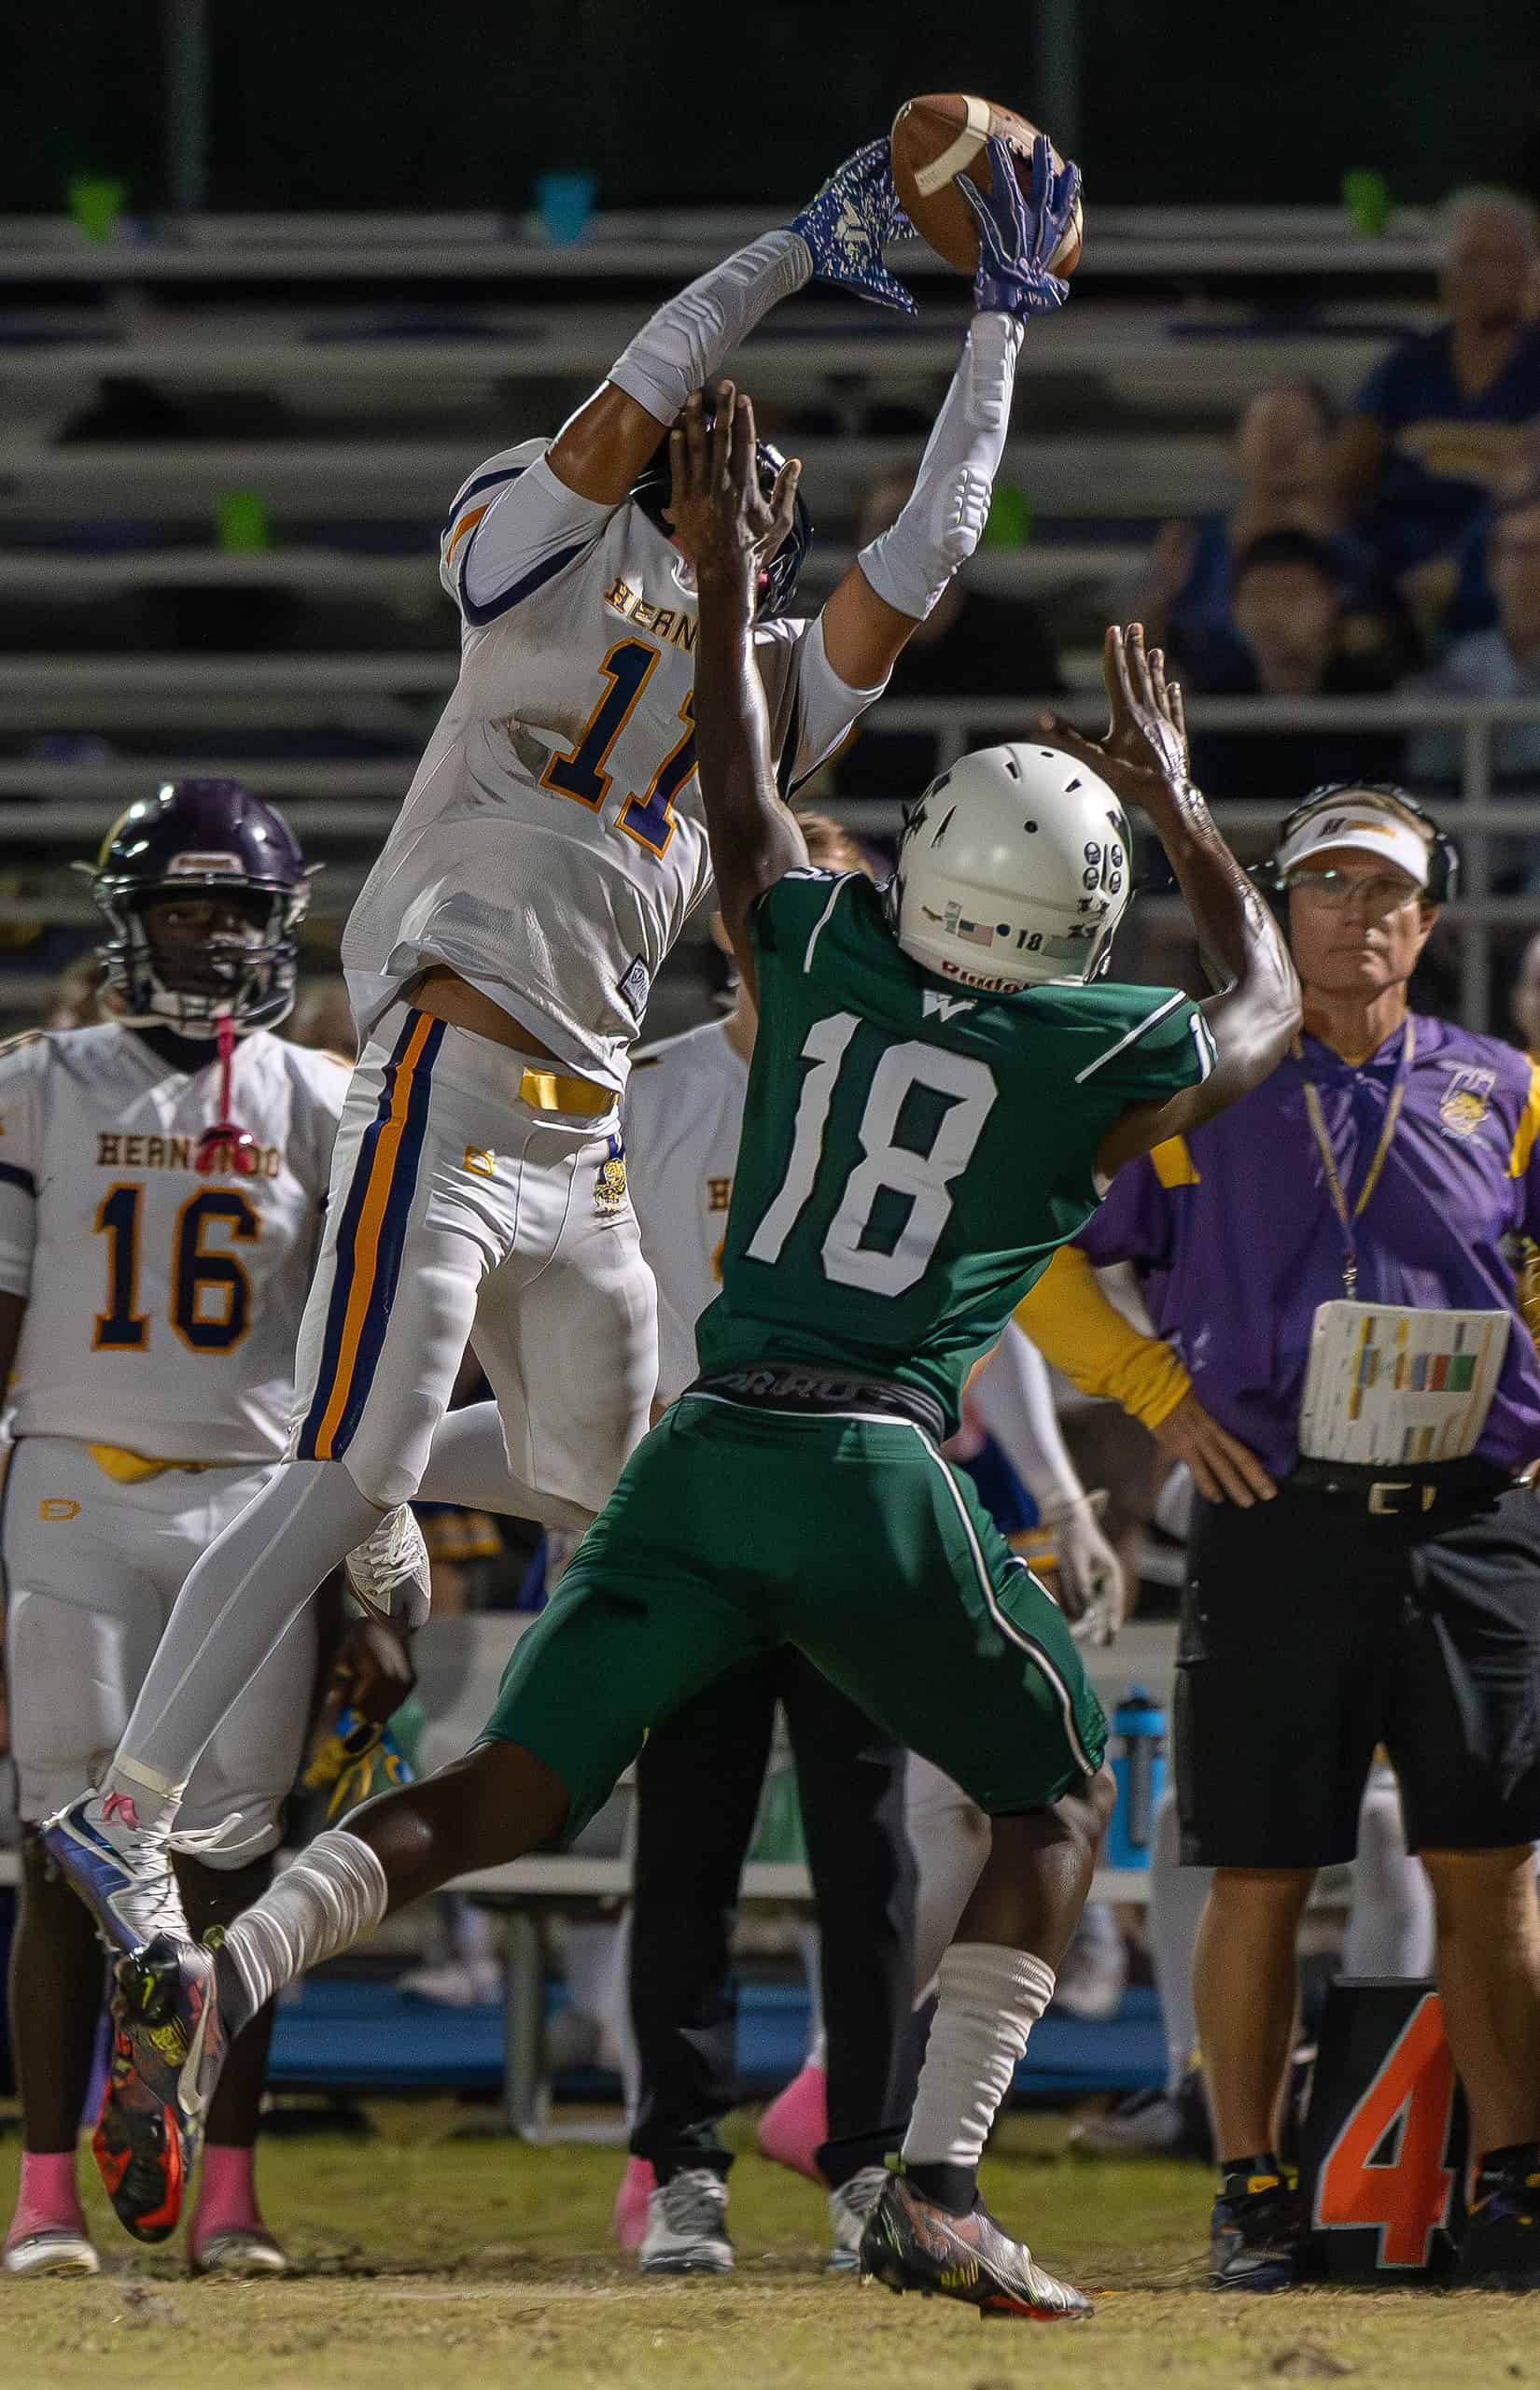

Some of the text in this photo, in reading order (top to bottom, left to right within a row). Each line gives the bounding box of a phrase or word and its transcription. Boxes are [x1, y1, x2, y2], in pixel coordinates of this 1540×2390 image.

[539, 637, 698, 860] 11
[921, 989, 977, 1022] W
[1015, 929, 1044, 952] 18
[745, 1011, 999, 1298] 18
[91, 1180, 264, 1357] 16
[1311, 1991, 1455, 2269] 4
